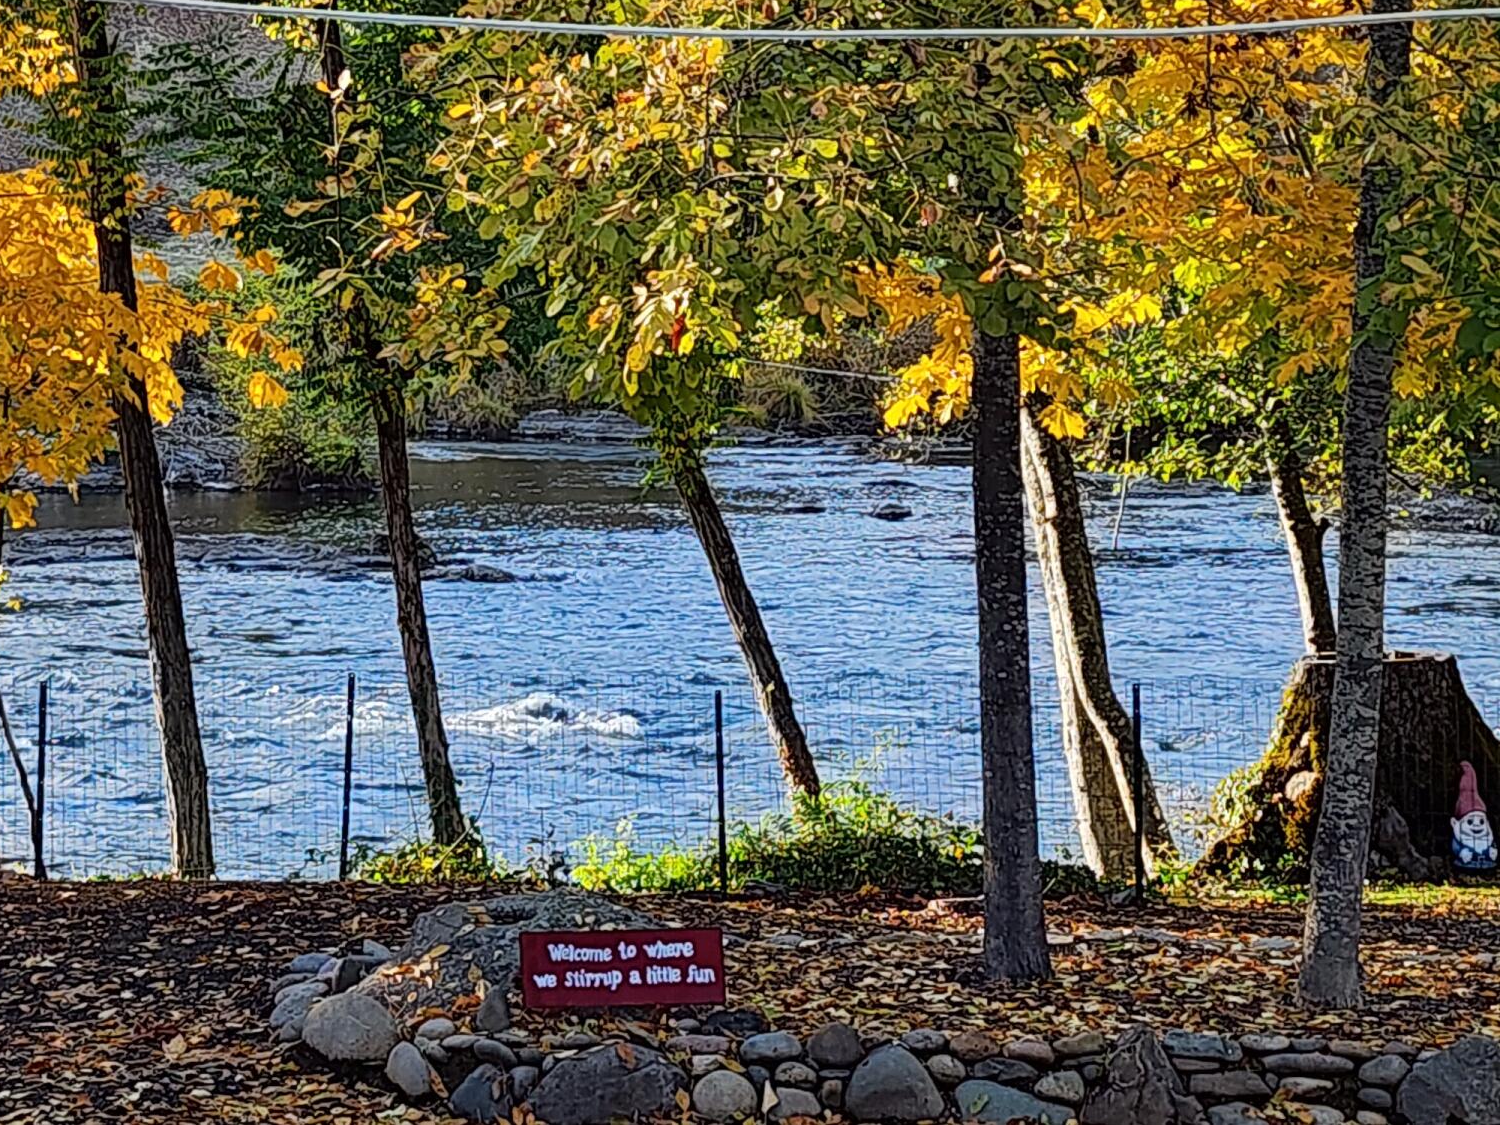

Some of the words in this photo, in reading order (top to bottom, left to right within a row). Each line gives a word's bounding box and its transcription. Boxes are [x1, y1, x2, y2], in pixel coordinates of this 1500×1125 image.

[547, 943, 613, 962] Welcome
[618, 941, 637, 961] to
[643, 940, 694, 959] where
[533, 973, 557, 989] we
[564, 969, 622, 991] stirrup
[629, 969, 642, 985] a
[646, 965, 681, 985] little
[686, 964, 716, 984] fun
